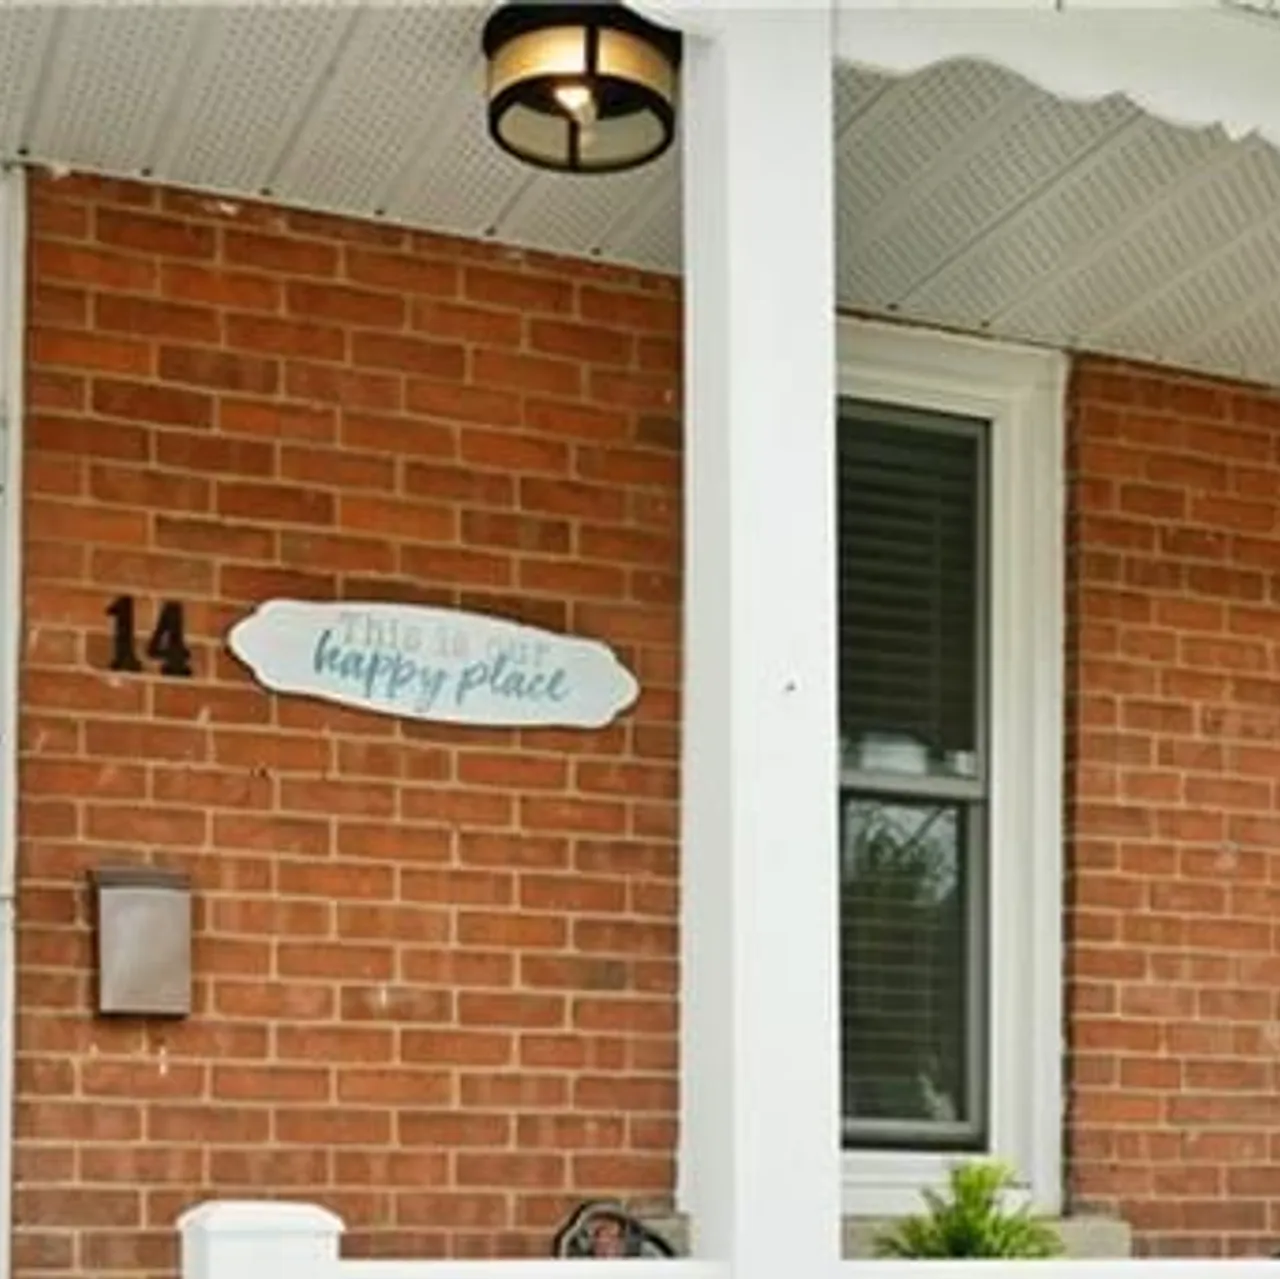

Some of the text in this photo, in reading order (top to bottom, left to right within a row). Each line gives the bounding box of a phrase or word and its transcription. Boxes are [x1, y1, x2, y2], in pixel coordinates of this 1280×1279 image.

[105, 596, 191, 675] 14
[314, 629, 570, 712] happy place
[340, 611, 422, 653] This
